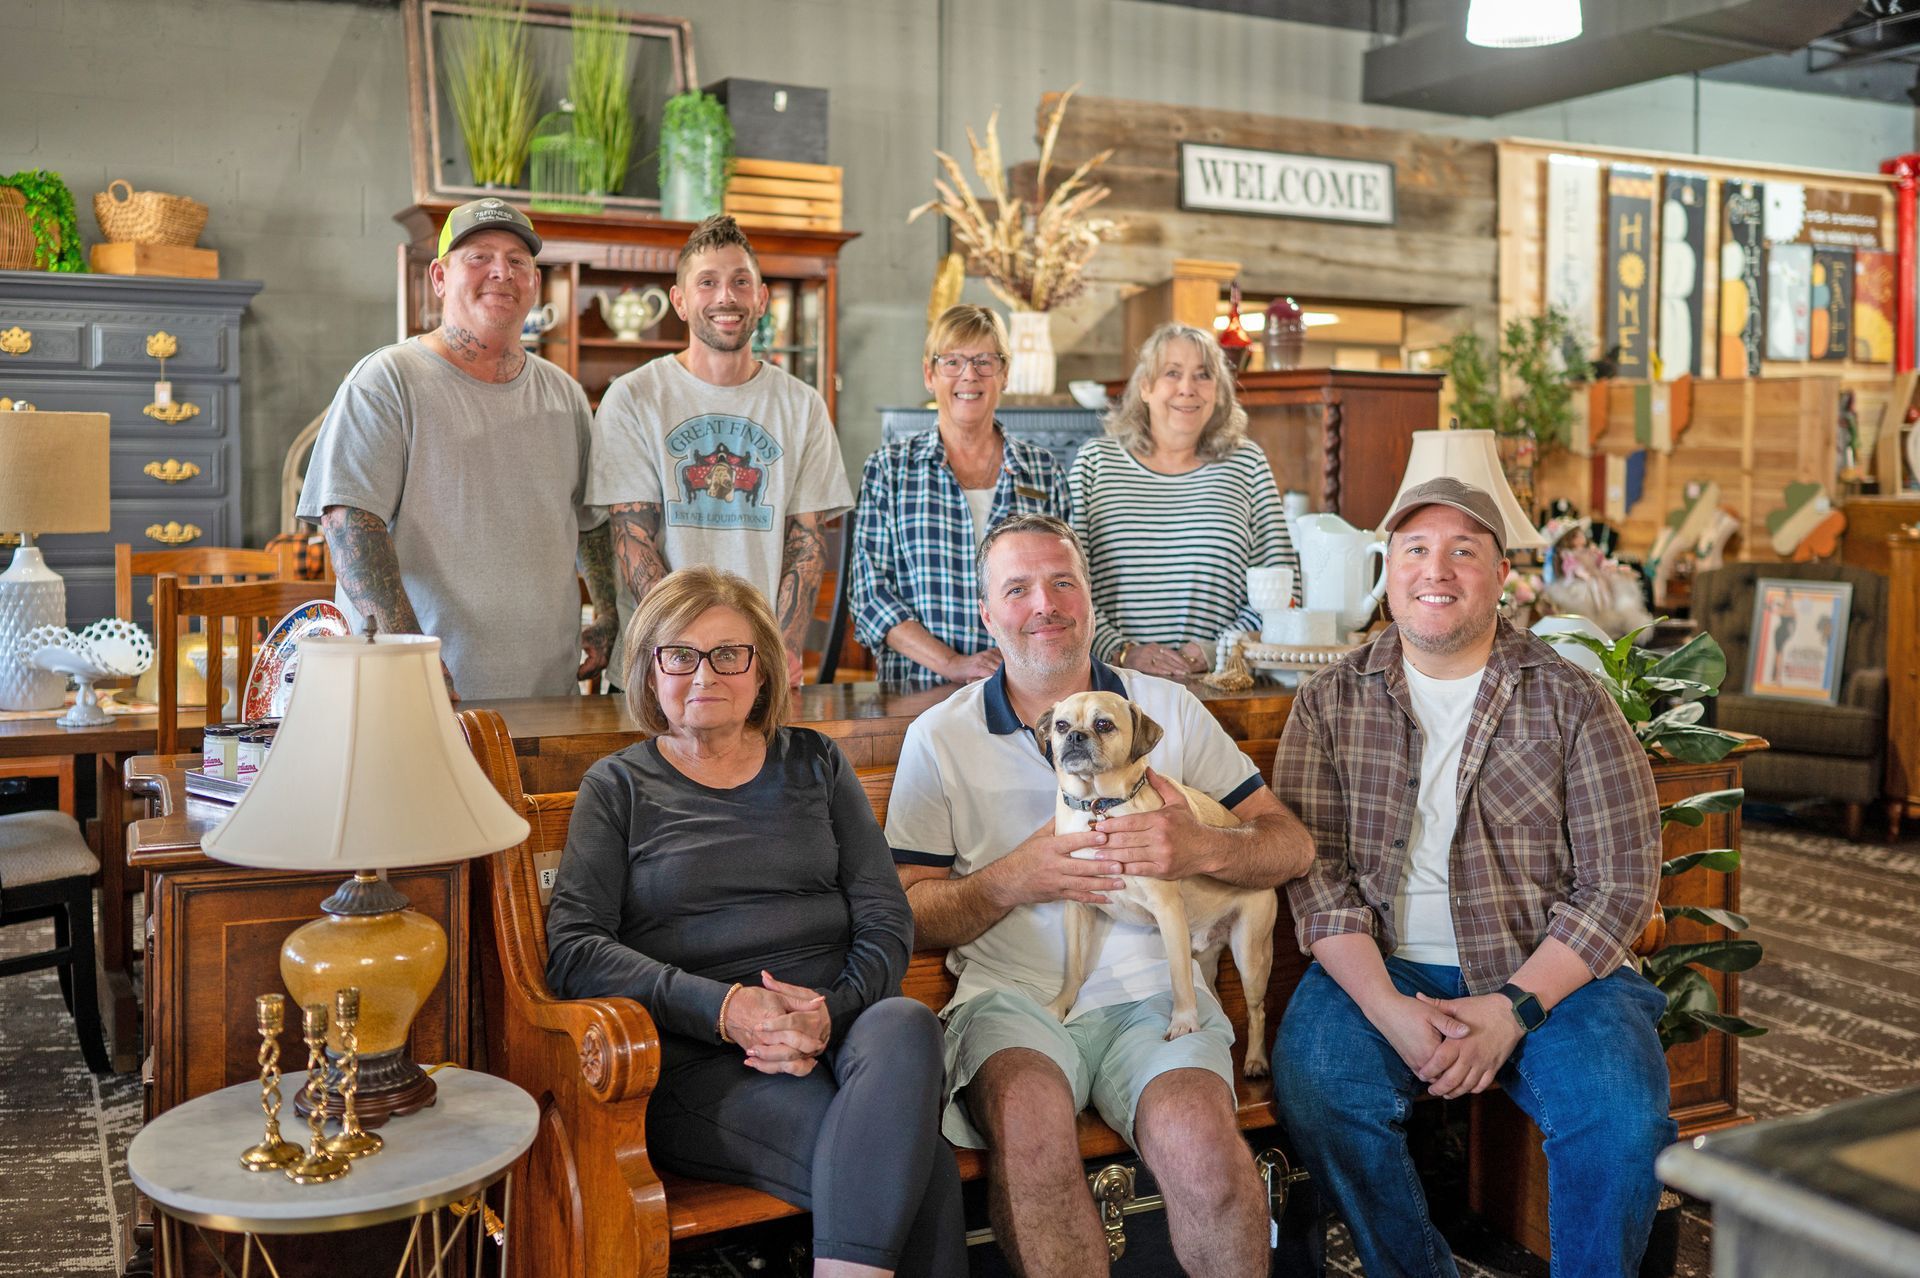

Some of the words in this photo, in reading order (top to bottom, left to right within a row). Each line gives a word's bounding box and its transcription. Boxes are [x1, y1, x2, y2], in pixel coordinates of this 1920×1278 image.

[1196, 157, 1380, 212] WELCOME
[671, 420, 725, 453] GREAT
[730, 422, 777, 460] FINDS
[674, 511, 705, 522] ESTATE
[706, 512, 768, 524] LIQUIDATIONS
